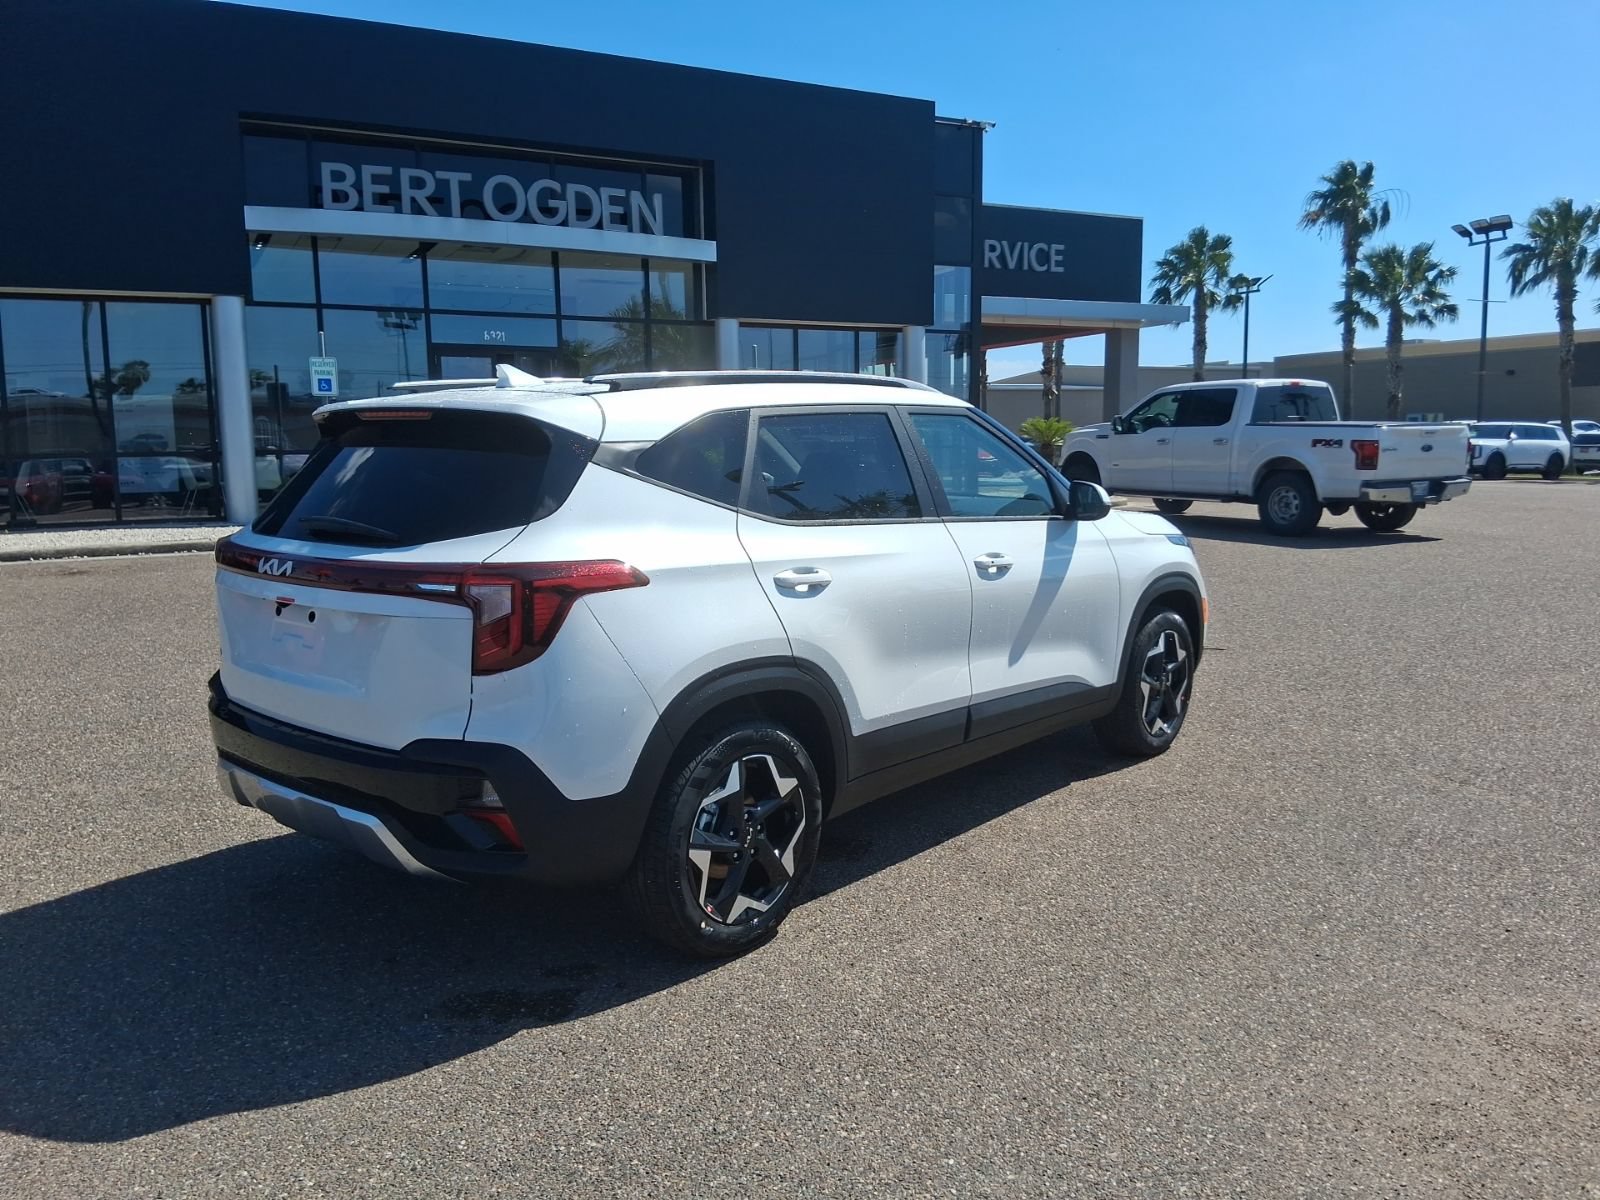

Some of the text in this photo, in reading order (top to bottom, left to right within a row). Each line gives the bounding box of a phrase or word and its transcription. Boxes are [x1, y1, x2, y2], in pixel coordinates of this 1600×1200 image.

[321, 161, 664, 236] BERT OGDEN
[983, 239, 1065, 273] RVICE
[1311, 438, 1343, 449] FX4
[257, 556, 294, 577] KIA
